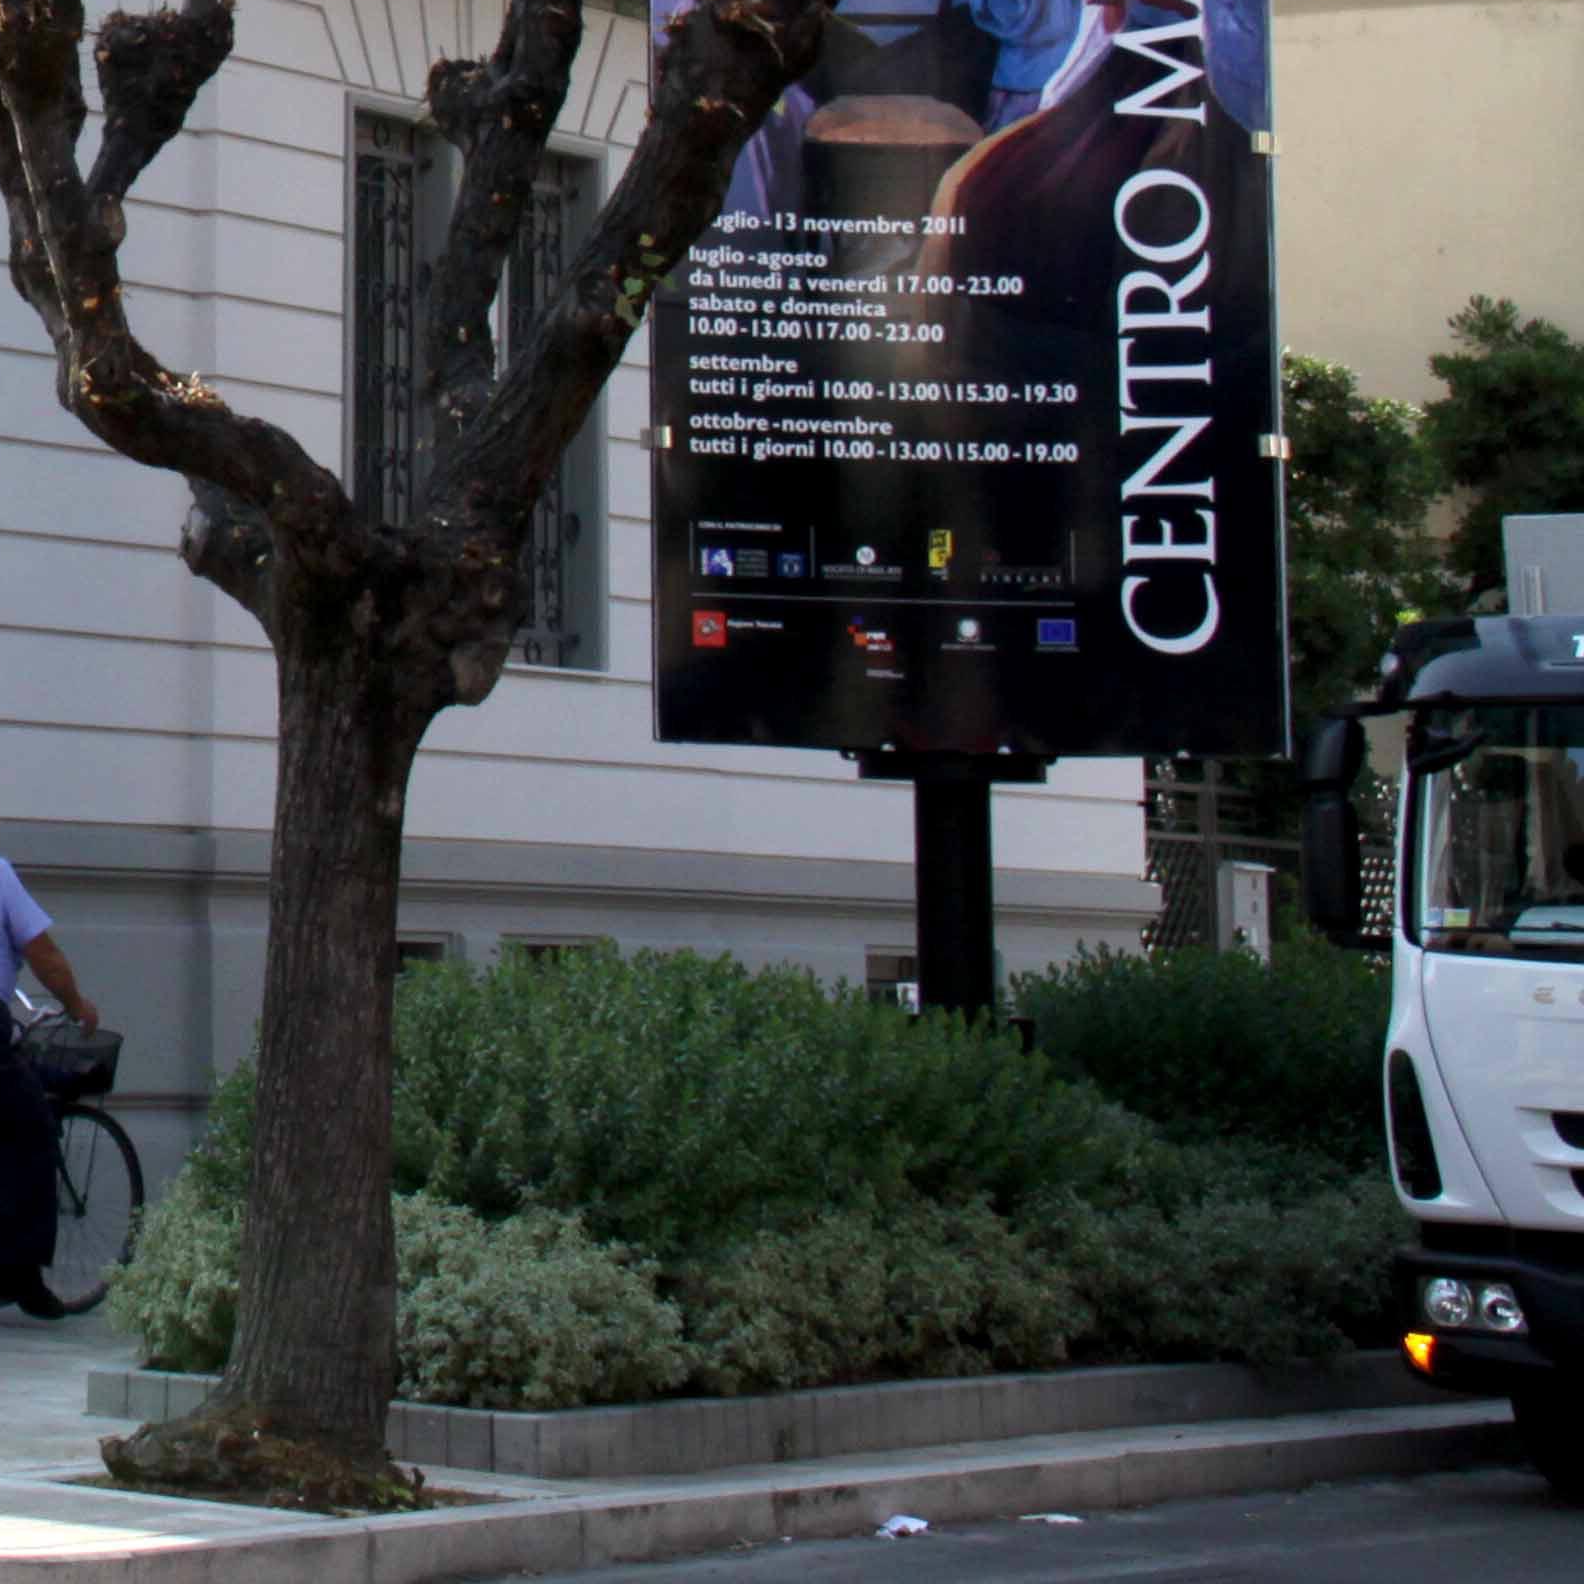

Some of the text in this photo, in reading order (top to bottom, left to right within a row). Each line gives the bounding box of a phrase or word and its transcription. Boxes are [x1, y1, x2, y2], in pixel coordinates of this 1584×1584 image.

[712, 211, 760, 233] uglio
[803, 215, 915, 235] novembre
[921, 216, 967, 235] 2011
[689, 268, 714, 287] da
[788, 277, 801, 291] a
[689, 293, 887, 317] sabato e domenica
[689, 354, 799, 373] settembre
[689, 377, 735, 396] tutti
[740, 377, 748, 396] i
[753, 379, 816, 402] giorni
[1113, 168, 1220, 655] CENTRO
[689, 436, 736, 455] tutti
[741, 437, 748, 455] i
[753, 438, 816, 461] giorni
